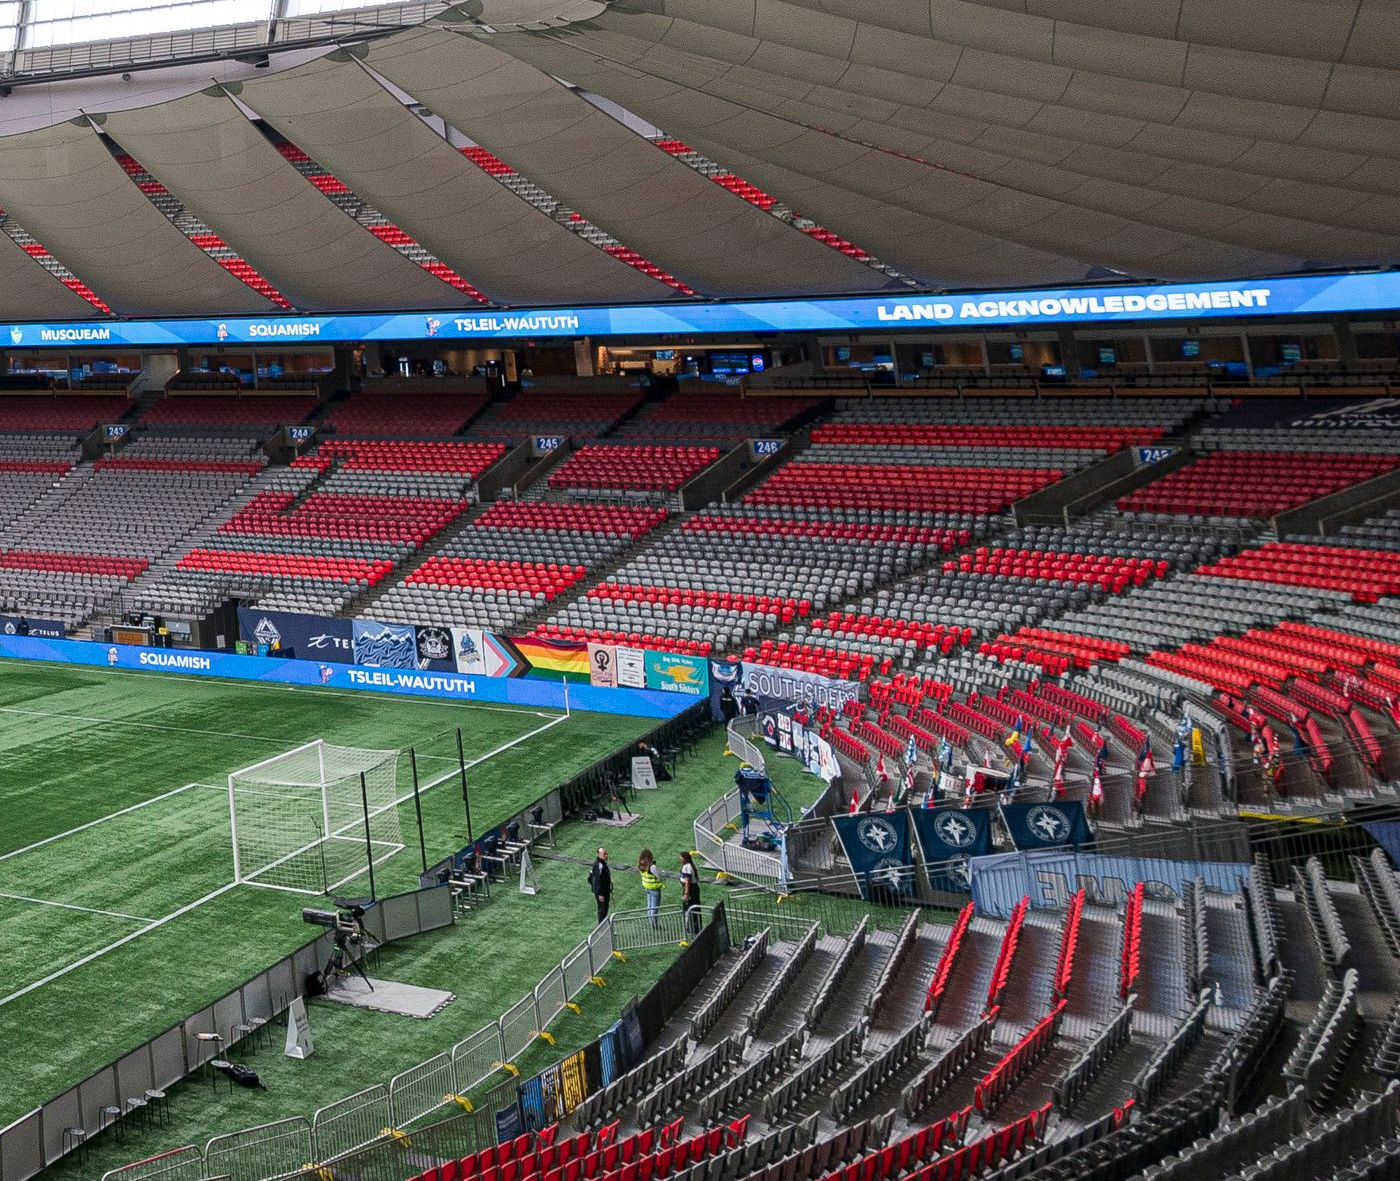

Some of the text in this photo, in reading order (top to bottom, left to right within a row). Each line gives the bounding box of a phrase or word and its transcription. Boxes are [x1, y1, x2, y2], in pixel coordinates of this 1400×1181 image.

[877, 289, 1271, 321] LAND ACKNOWLEDGEMENT
[249, 323, 320, 337] SQUAMISH
[454, 315, 579, 333] TSLEIL-WAUTUTH
[41, 328, 110, 341] MUSQUEAM
[539, 438, 559, 450] 245
[757, 441, 778, 455] 246
[39, 629, 60, 637] TELUS
[139, 652, 211, 670] SQUAMISH
[347, 669, 476, 693] TSLEIL-WAUTUTH
